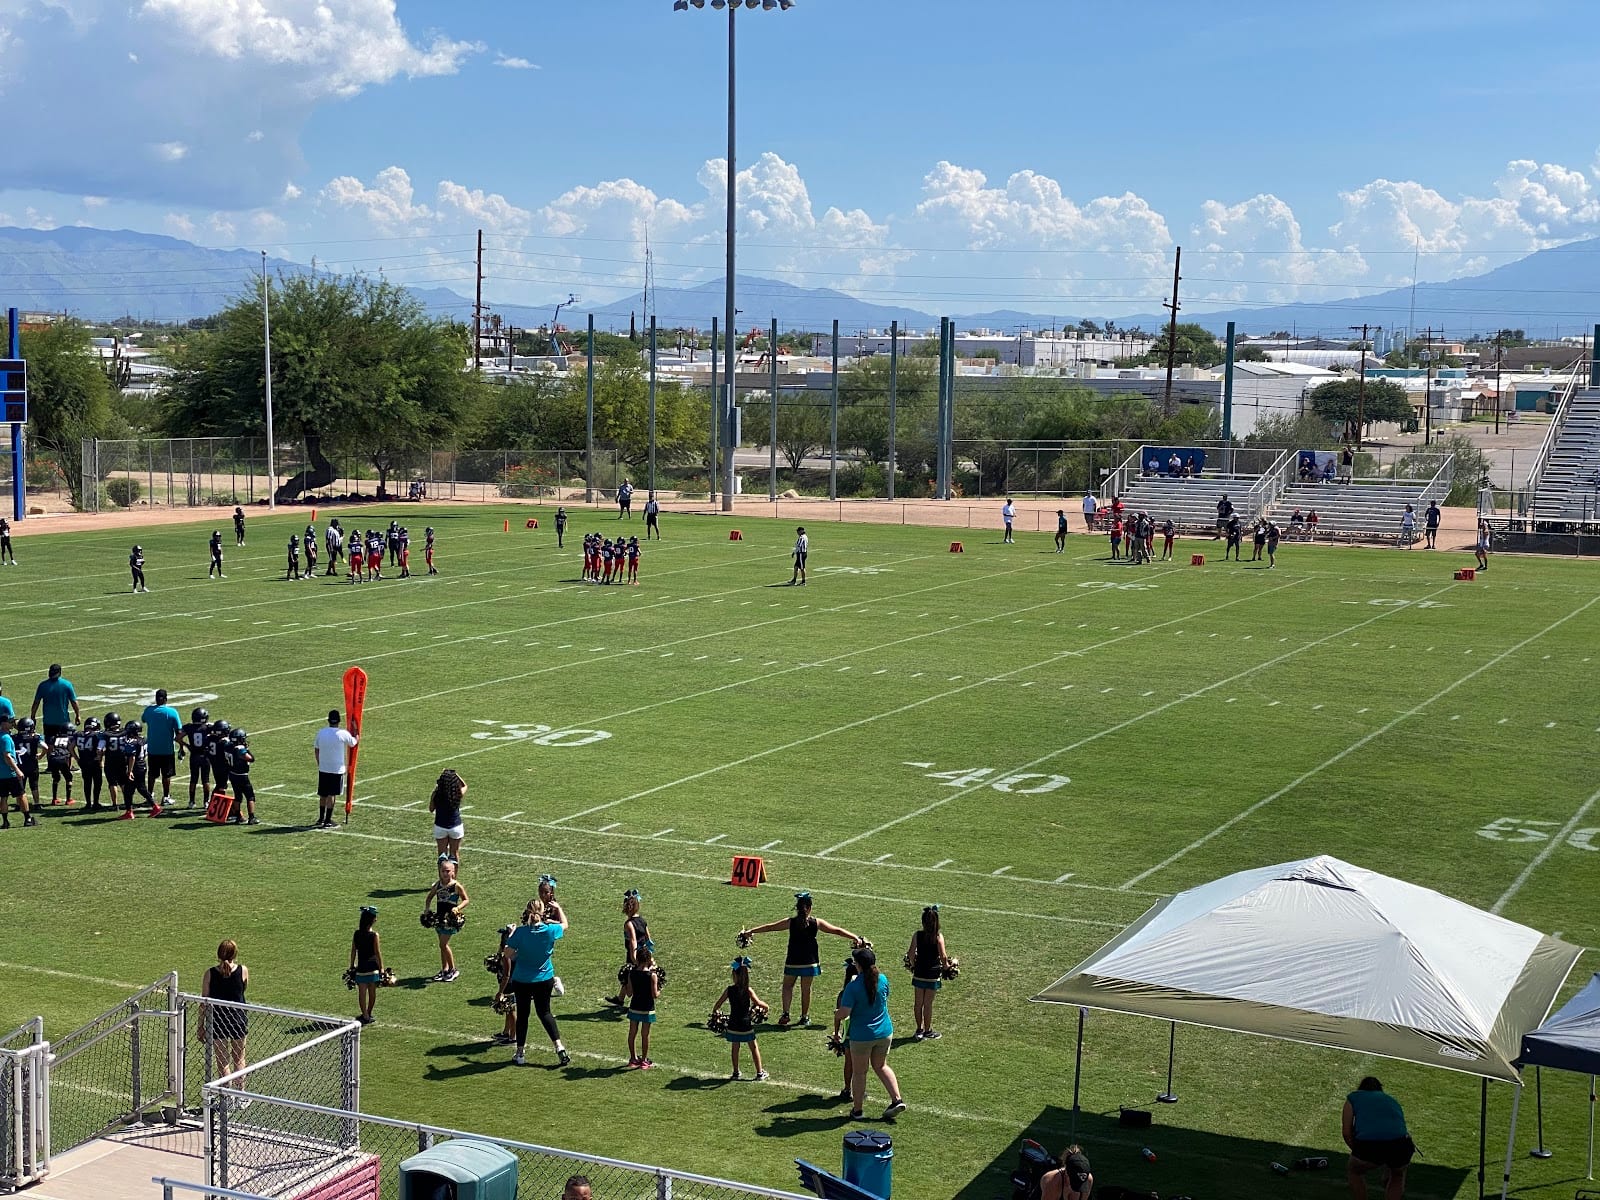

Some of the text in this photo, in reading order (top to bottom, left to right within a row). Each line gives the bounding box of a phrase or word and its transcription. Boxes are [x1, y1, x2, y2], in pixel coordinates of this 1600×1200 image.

[77, 737, 93, 751] 54
[193, 732, 203, 747] 8
[470, 723, 612, 747] 30
[925, 768, 1071, 794] 40
[208, 799, 227, 820] 30
[732, 857, 757, 884] 40
